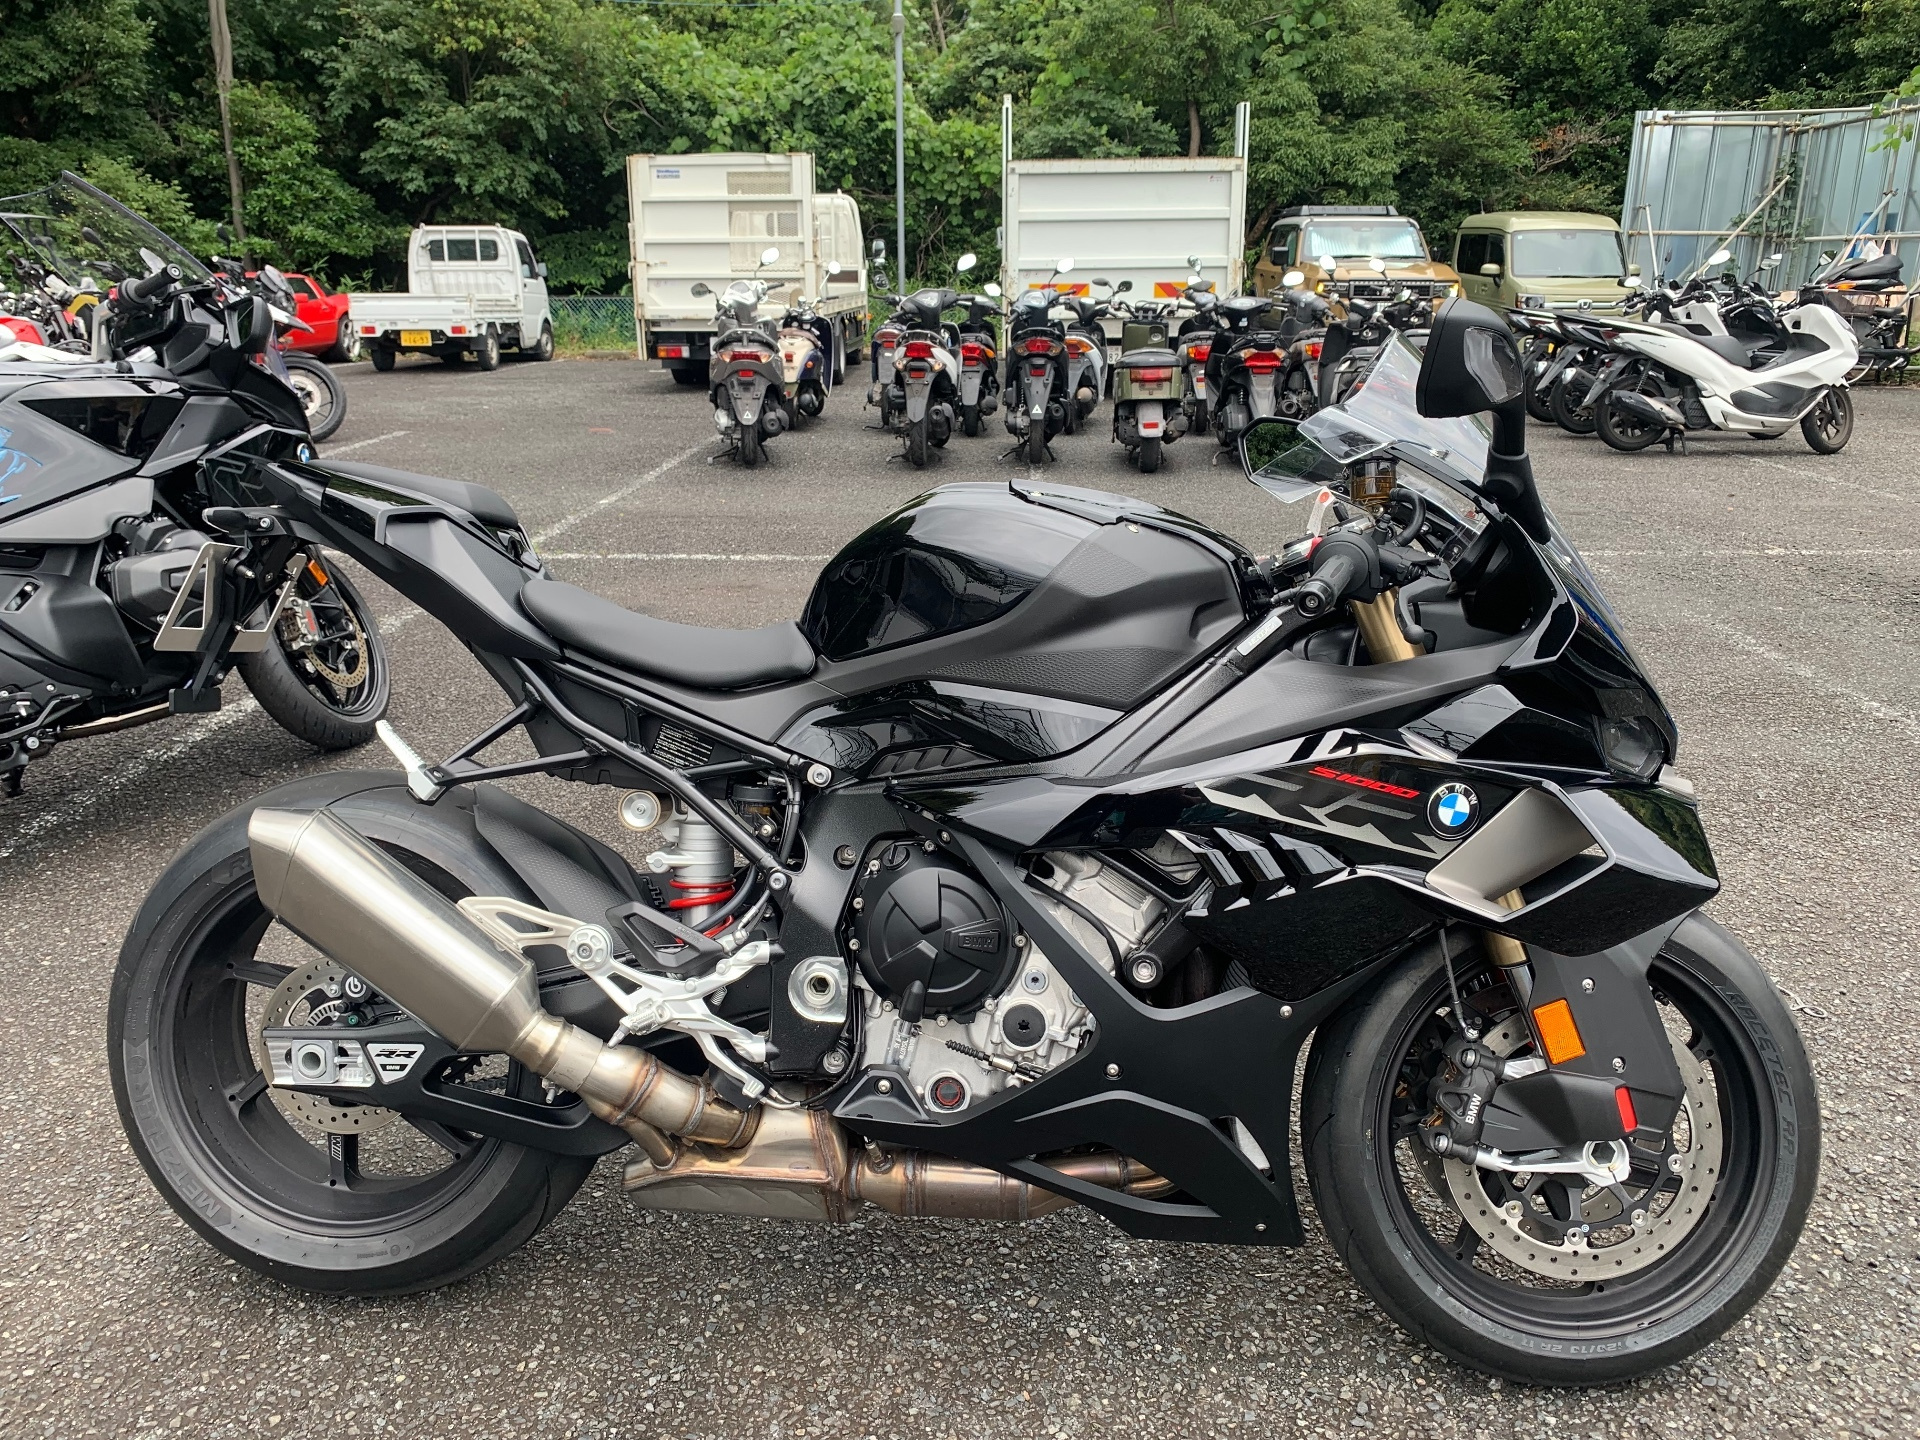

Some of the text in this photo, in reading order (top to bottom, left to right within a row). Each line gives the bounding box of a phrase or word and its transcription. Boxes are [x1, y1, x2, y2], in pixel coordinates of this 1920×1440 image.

[1309, 766, 1420, 799] S1000
[1438, 783, 1479, 806] BMW
[962, 936, 995, 948] BMW
[374, 1050, 418, 1059] RR
[1465, 1093, 1482, 1125] BMW
